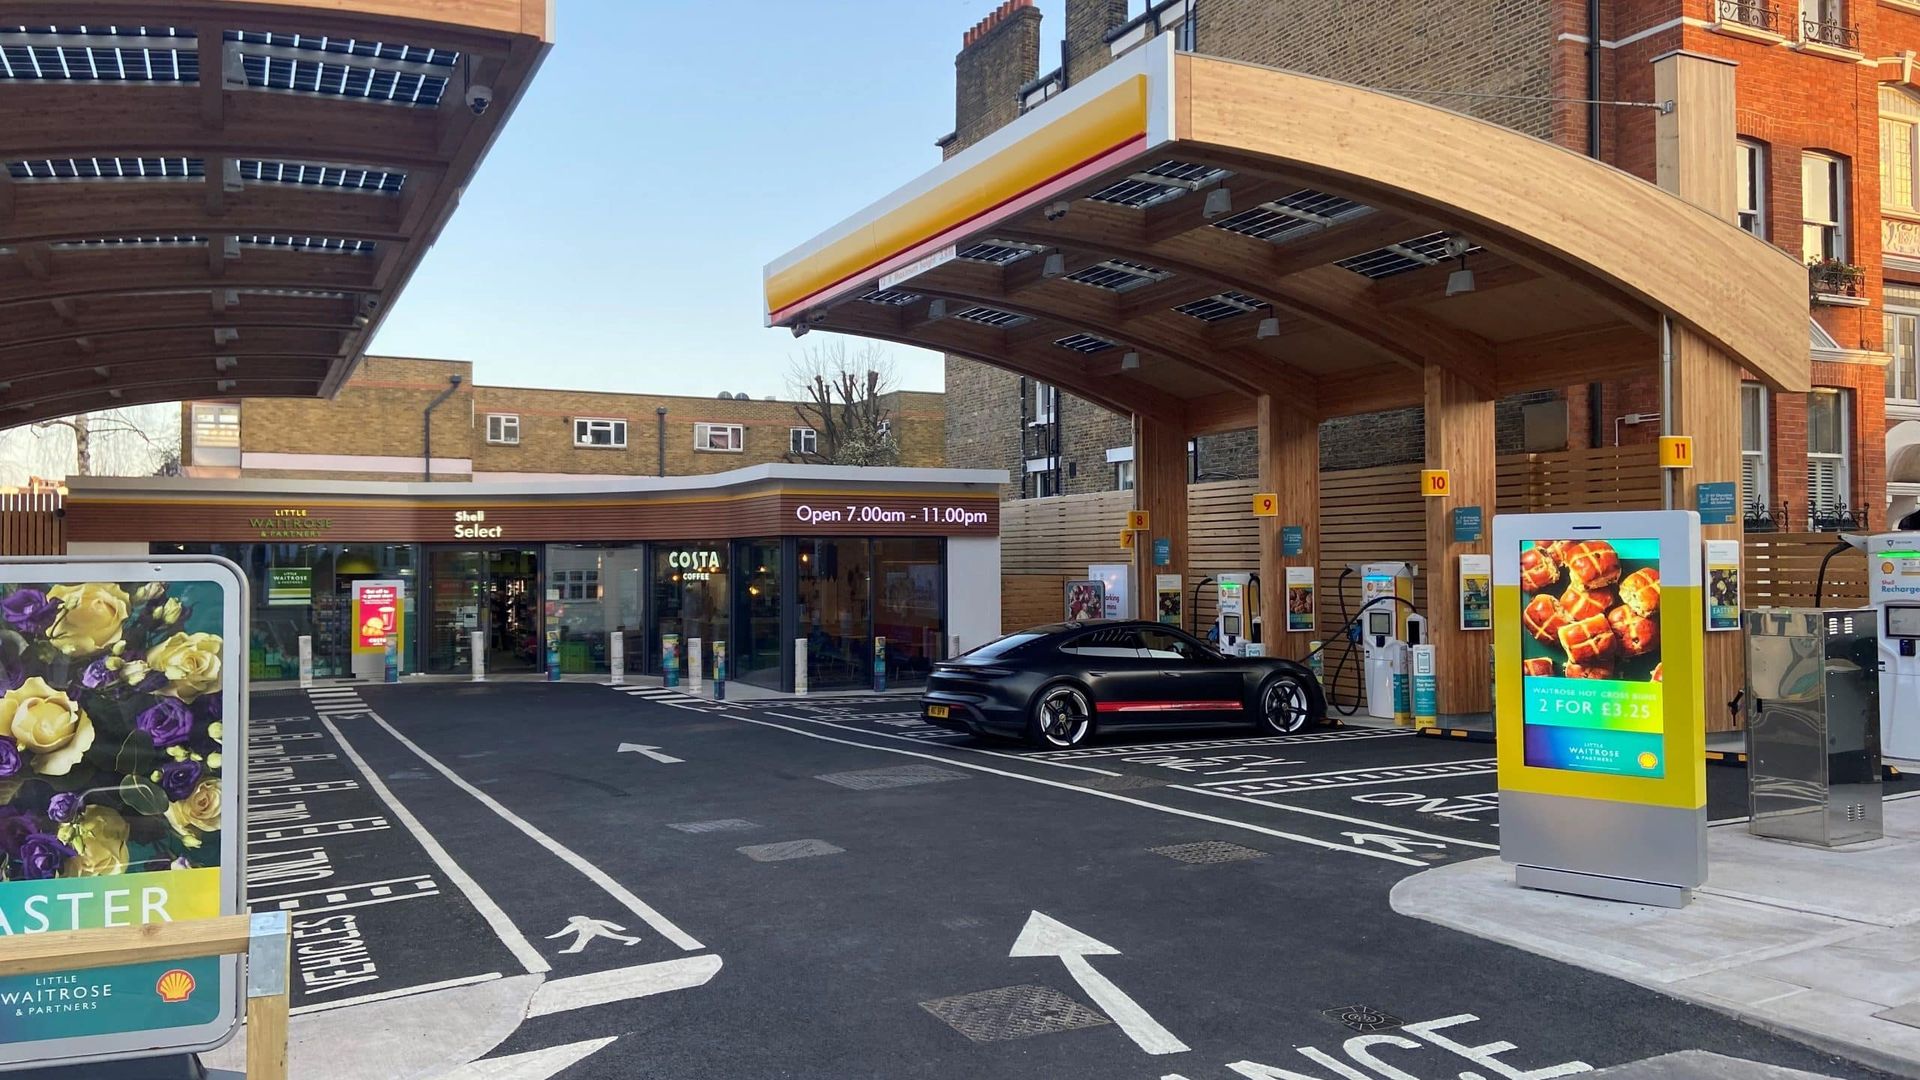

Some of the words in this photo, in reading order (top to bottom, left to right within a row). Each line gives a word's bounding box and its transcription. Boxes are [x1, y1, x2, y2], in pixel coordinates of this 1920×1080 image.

[1675, 443, 1686, 459] 11
[1431, 476, 1445, 490] 10
[1263, 499, 1272, 510] 9
[455, 511, 485, 521] Shell
[796, 505, 841, 524] Open
[846, 506, 905, 522] 7.00am
[922, 507, 987, 526] 11.00pm
[1136, 515, 1143, 525] 8
[250, 518, 333, 528] WAITROSE
[455, 523, 503, 538] Select
[1126, 534, 1133, 544] 7
[668, 551, 720, 570] COSTA
[1105, 595, 1120, 603] arking
[1533, 687, 1576, 697] WAITROSE
[1578, 689, 1597, 697] HOT
[1539, 699, 1548, 712] 2
[1556, 700, 1593, 714] FOR
[1601, 701, 1651, 719] £3.25
[1569, 747, 1619, 758] WAITROSE
[1351, 792, 1499, 827] ONL
[293, 914, 380, 994] VEHICLES
[36, 975, 77, 986] LITTLE
[1, 984, 112, 1005] WAITROSE
[16, 1008, 23, 1016] &
[29, 1002, 97, 1015] PARTNERS
